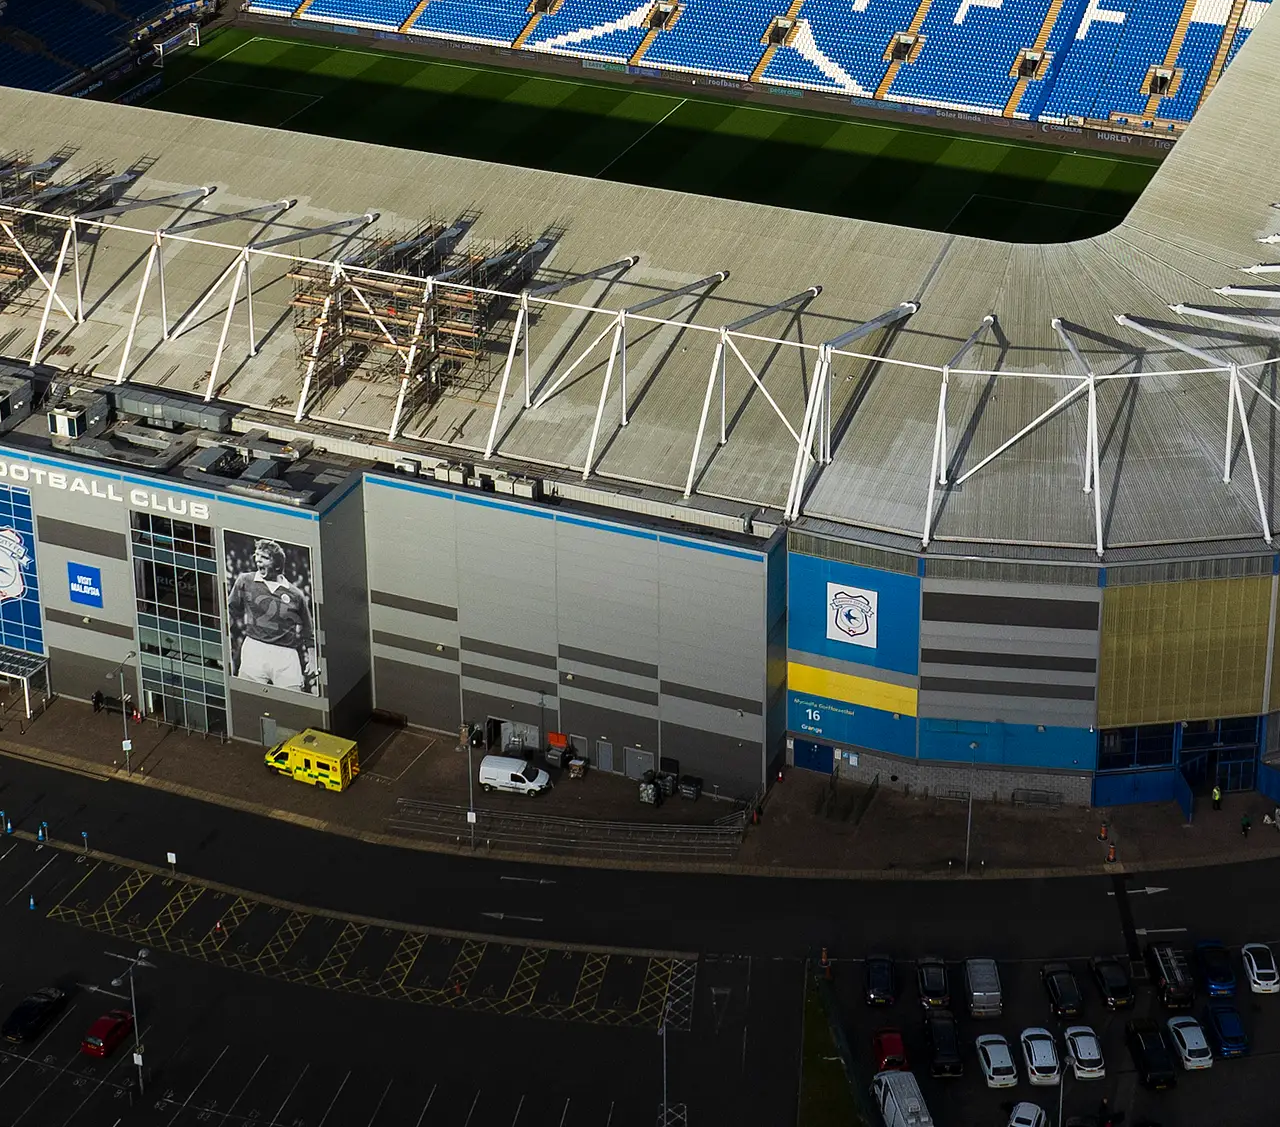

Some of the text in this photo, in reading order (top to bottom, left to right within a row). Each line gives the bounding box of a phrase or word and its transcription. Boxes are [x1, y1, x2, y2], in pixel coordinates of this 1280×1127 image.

[708, 77, 741, 89] roofbase
[1097, 131, 1134, 144] HURLEY
[129, 487, 212, 521] CLUB
[76, 574, 92, 587] VISIT
[155, 574, 199, 592] RICOH
[70, 583, 100, 598] MALAYSIA
[805, 708, 821, 721] 16
